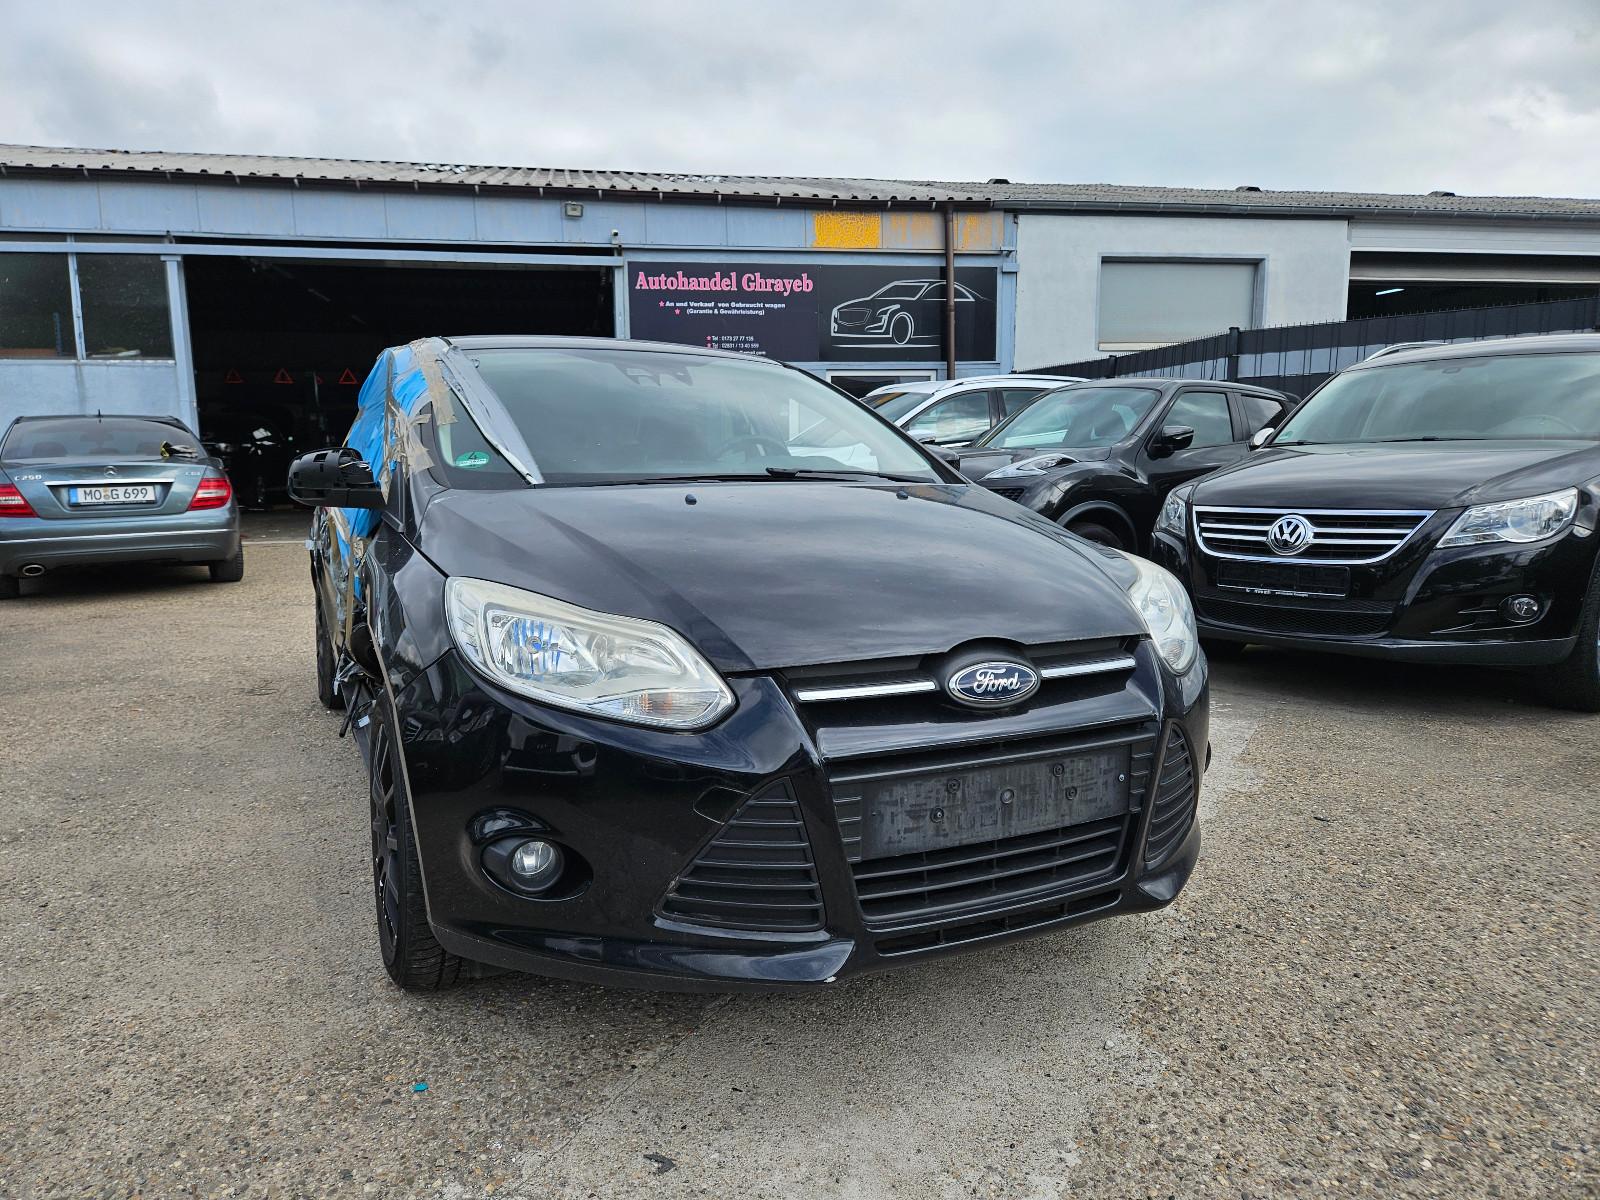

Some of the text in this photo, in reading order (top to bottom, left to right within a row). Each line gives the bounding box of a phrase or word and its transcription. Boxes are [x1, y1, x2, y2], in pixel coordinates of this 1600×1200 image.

[635, 271, 814, 297] Autohandel Ghrayeb
[731, 301, 764, 309] Gebraucht
[720, 308, 765, 316] Gewährleistung)
[83, 488, 148, 501] MO G 699
[973, 668, 1020, 694] Ford
